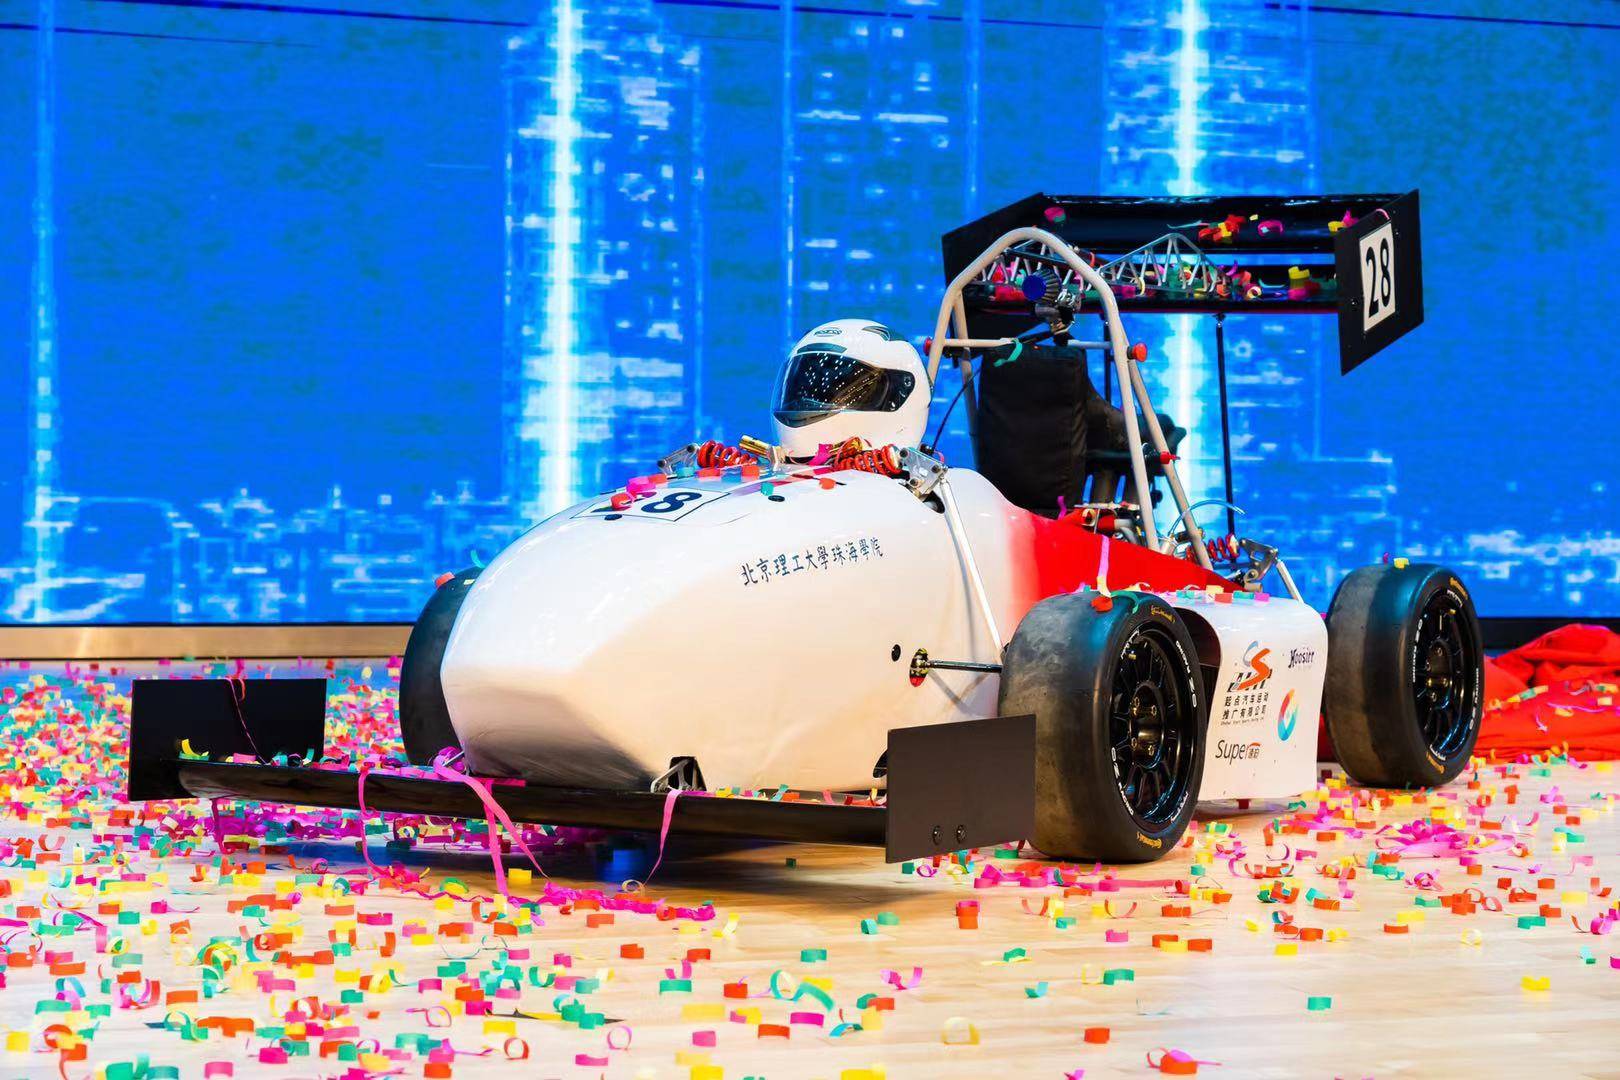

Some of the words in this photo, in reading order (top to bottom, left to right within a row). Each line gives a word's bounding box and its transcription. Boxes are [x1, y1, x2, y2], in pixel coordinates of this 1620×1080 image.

[1365, 238, 1391, 318] 28
[741, 537, 884, 586] 北京理工大學珠海學院
